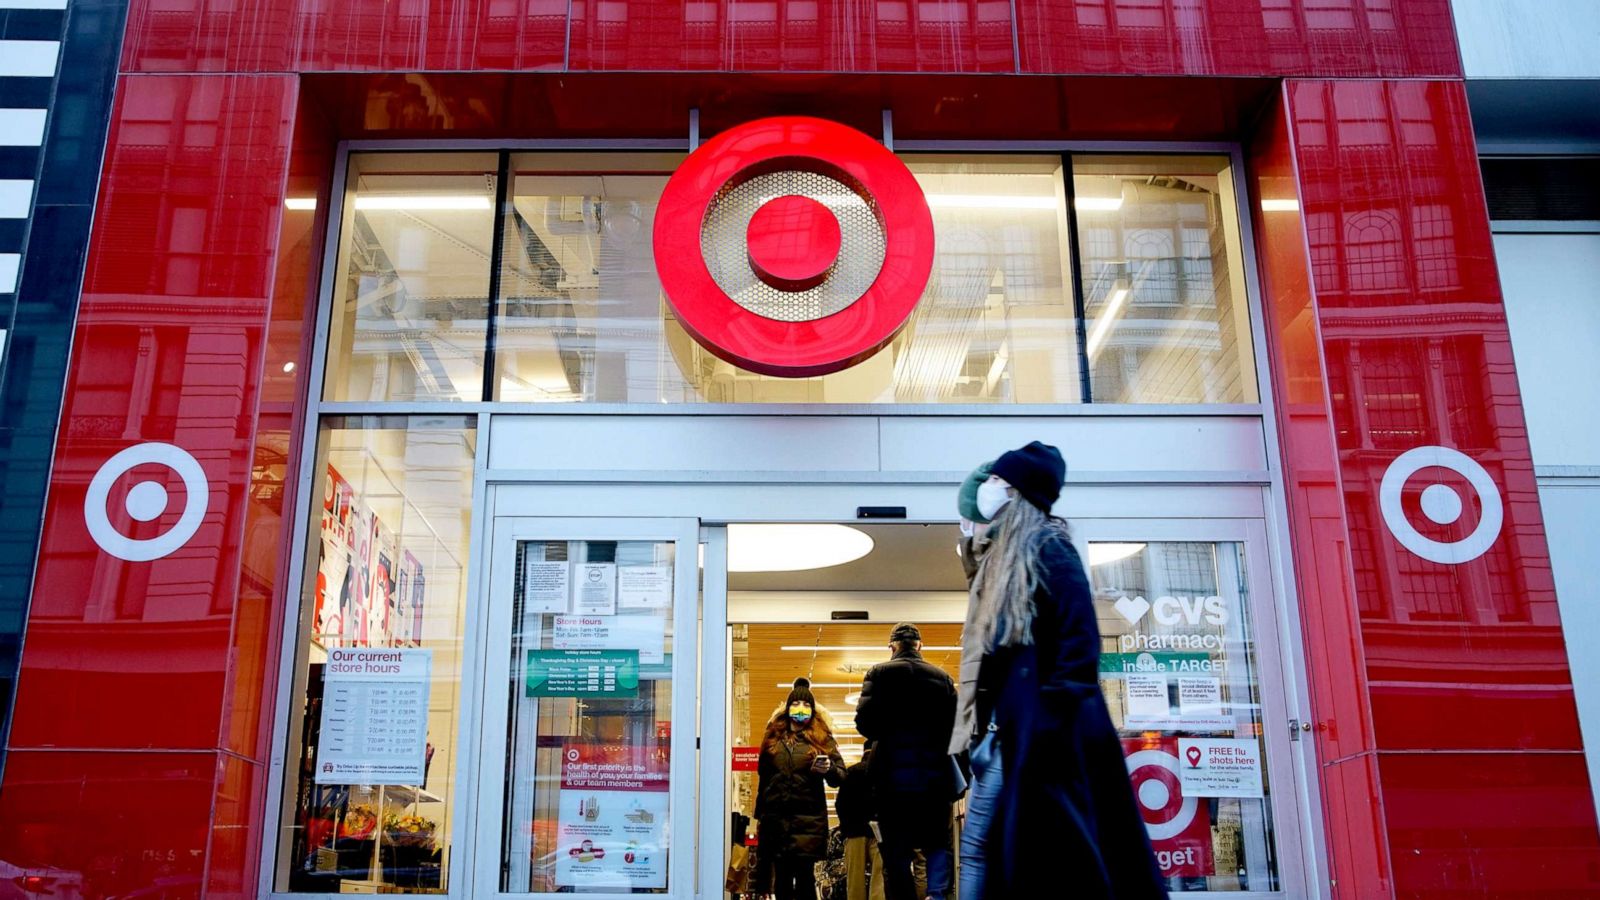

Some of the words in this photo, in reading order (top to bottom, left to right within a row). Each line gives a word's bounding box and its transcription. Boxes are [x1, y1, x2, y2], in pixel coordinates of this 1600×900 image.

[1152, 596, 1230, 625] CVS
[1120, 630, 1226, 652] pharmacy
[332, 650, 356, 662] Our
[358, 652, 402, 662] current
[331, 664, 362, 673] store
[365, 663, 400, 674] hours
[1122, 658, 1166, 672] inside
[1169, 660, 1230, 672] TARGET
[598, 764, 625, 772] priority
[1154, 847, 1195, 870] get
